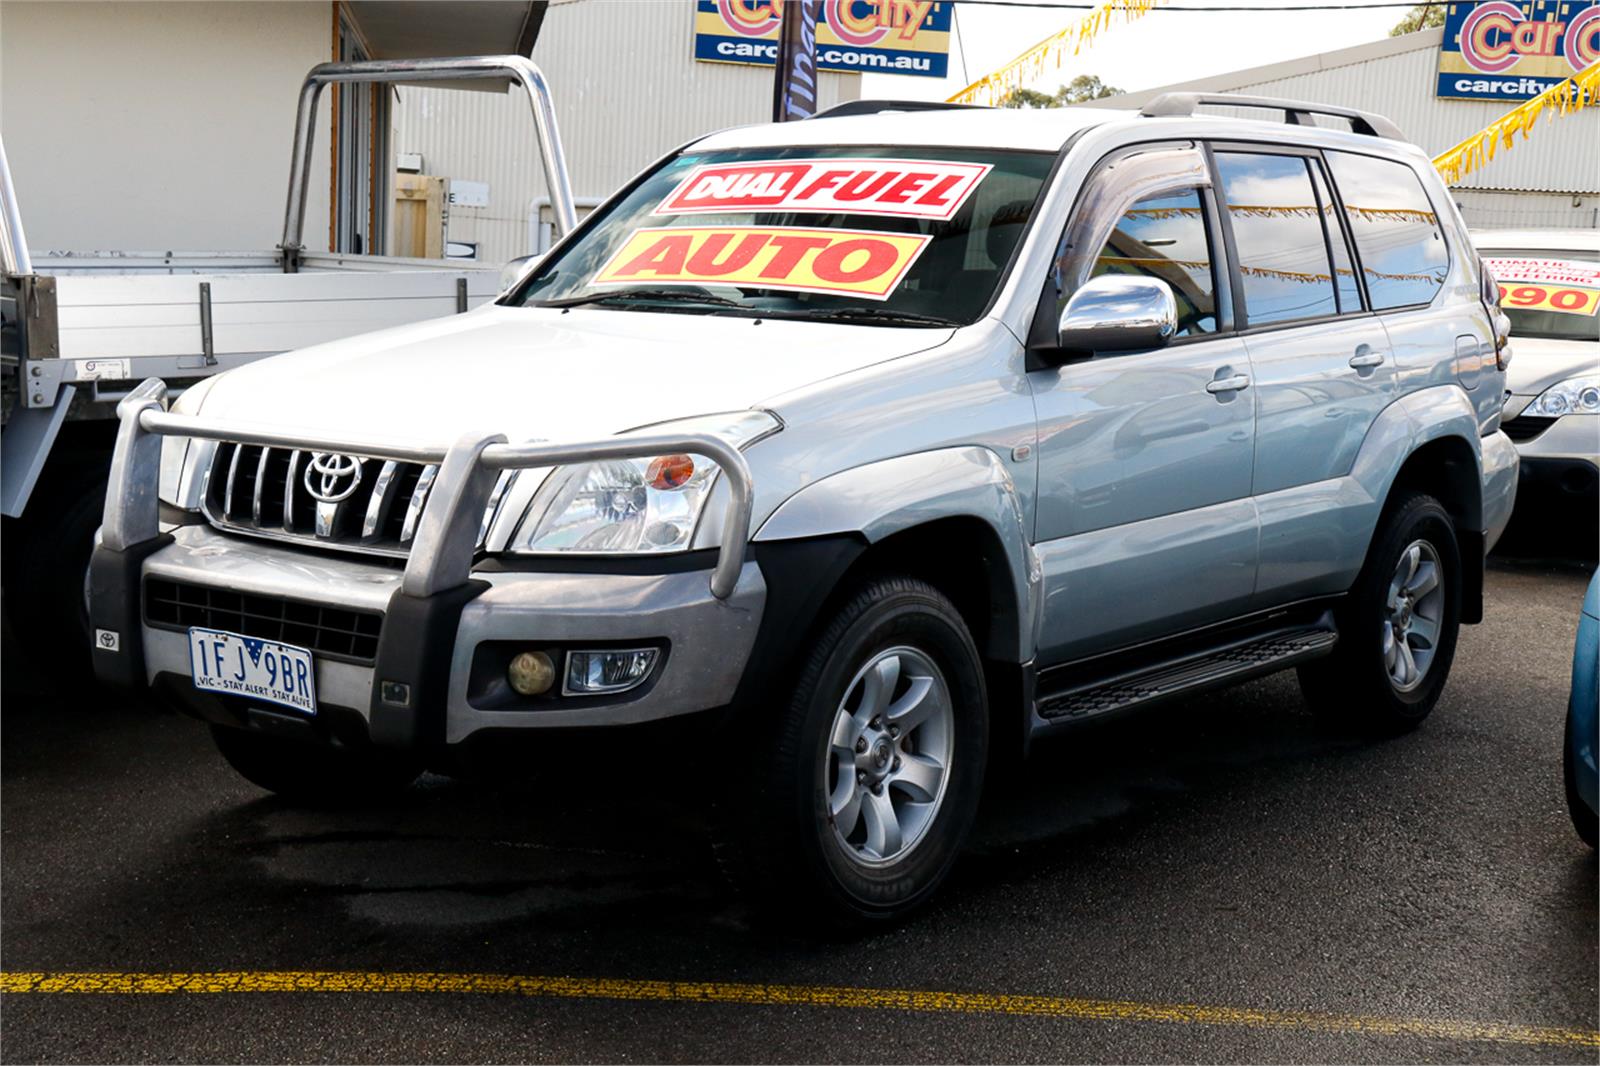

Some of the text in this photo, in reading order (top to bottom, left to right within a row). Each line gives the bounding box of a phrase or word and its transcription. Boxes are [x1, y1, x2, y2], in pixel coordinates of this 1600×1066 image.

[1460, 1, 1566, 72] Car
[688, 170, 965, 205] DUAL FUEL
[612, 233, 899, 284] AUTO
[198, 639, 310, 698] 1FJ 9BR
[199, 677, 215, 687] VIC
[223, 680, 243, 691] STAY
[245, 684, 269, 696] ALERT
[272, 689, 290, 702] STAY
[291, 695, 311, 708] ALIVE
